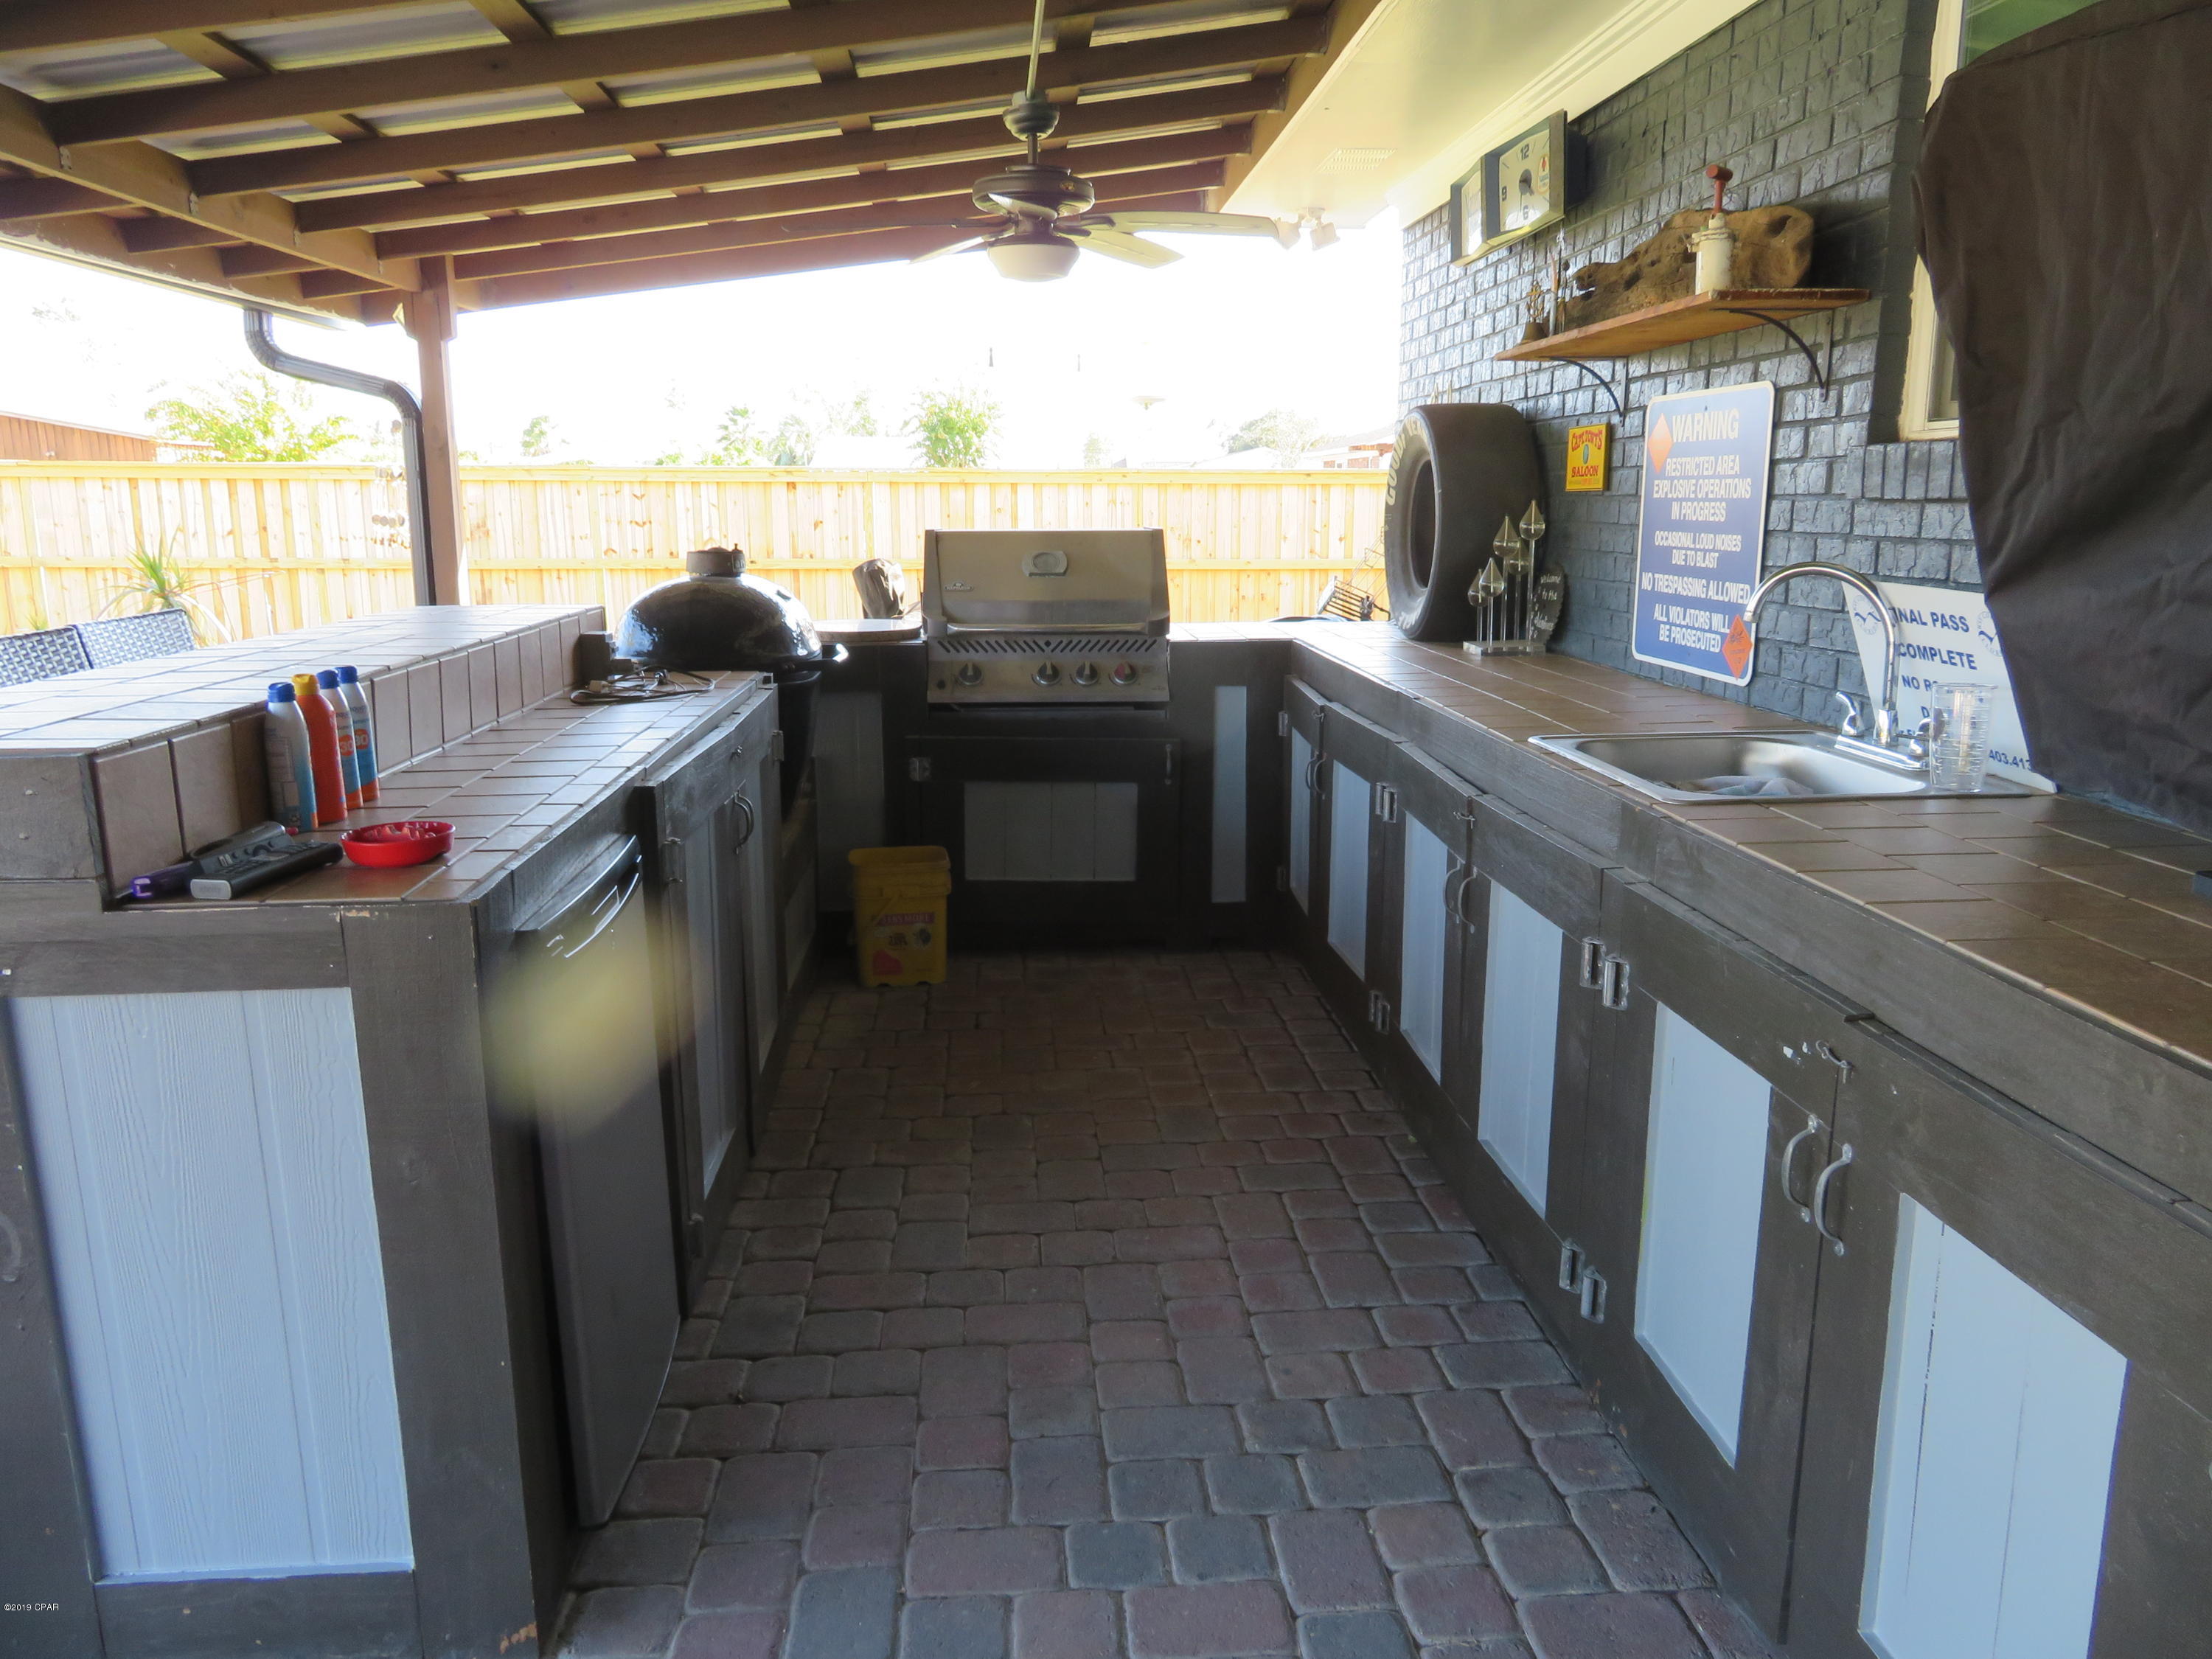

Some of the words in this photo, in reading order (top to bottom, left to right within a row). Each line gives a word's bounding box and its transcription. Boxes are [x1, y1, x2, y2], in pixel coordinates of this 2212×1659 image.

[1520, 144, 1530, 161] 12
[1501, 186, 1507, 201] 9
[1523, 205, 1528, 220] 6
[1672, 408, 1739, 443] WARNING
[1571, 465, 1599, 478] SALOON
[1666, 456, 1715, 476] RESTRICTED
[1716, 455, 1740, 476] AREA
[1653, 479, 1696, 498] EXPLOSIVE
[1697, 478, 1752, 499] OPERATIONS
[1671, 501, 1680, 520] IN
[1680, 501, 1726, 522] PROGRESS
[1655, 531, 1694, 548] OCCASIONAL
[1696, 532, 1714, 550] LOUD
[1715, 534, 1742, 552] NOISES
[1672, 549, 1685, 566] DUE
[1686, 551, 1695, 566] TO
[1696, 552, 1719, 568] BLAST
[1641, 572, 1653, 591] NO
[1654, 574, 1707, 599] TRESPASSING
[1707, 580, 1751, 605] ALLOWED
[1653, 603, 1668, 622] ALL
[1669, 605, 1710, 630] VIOLATORS
[1711, 613, 1730, 633] WILL
[1930, 611, 1969, 633] PASS
[1659, 624, 1670, 642] BE
[1670, 625, 1722, 653] PROSECUTED
[1897, 643, 1978, 670] COMPLETE
[1902, 675, 1920, 690] NO
